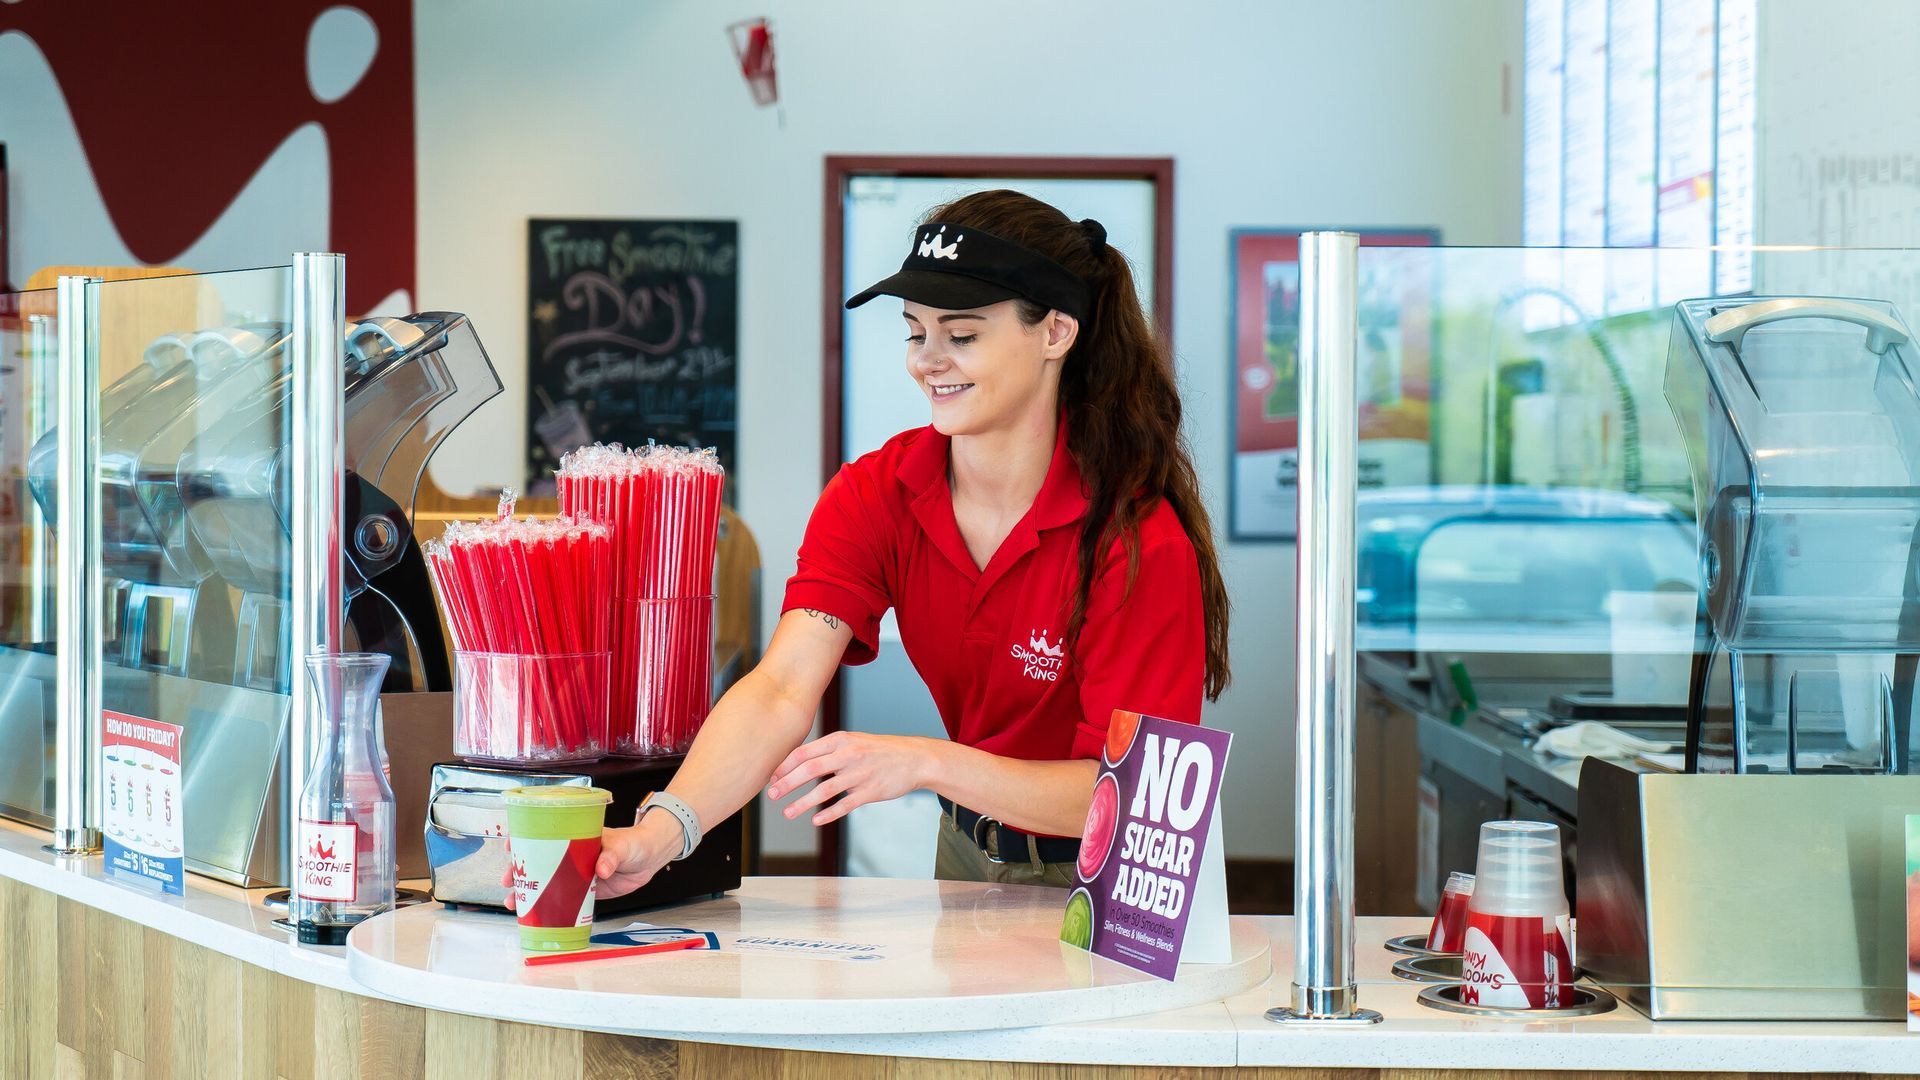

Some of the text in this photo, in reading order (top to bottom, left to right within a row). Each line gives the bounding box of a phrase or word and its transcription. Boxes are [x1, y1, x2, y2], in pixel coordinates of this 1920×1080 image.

[539, 226, 607, 280] Free
[542, 270, 706, 363] Day!
[106, 718, 175, 748] HOW DO YOU FRIDAY?
[1130, 733, 1213, 831] NO
[1120, 821, 1196, 877] SUGAR
[1111, 863, 1186, 920] ADDED
[1115, 907, 1131, 923] Over
[1130, 912, 1141, 927] 50
[1141, 916, 1175, 939] Smoothies
[1115, 924, 1131, 938] Fitness
[1130, 929, 1136, 940] &
[1135, 930, 1157, 947] Wellness
[1156, 938, 1174, 953] Blends
